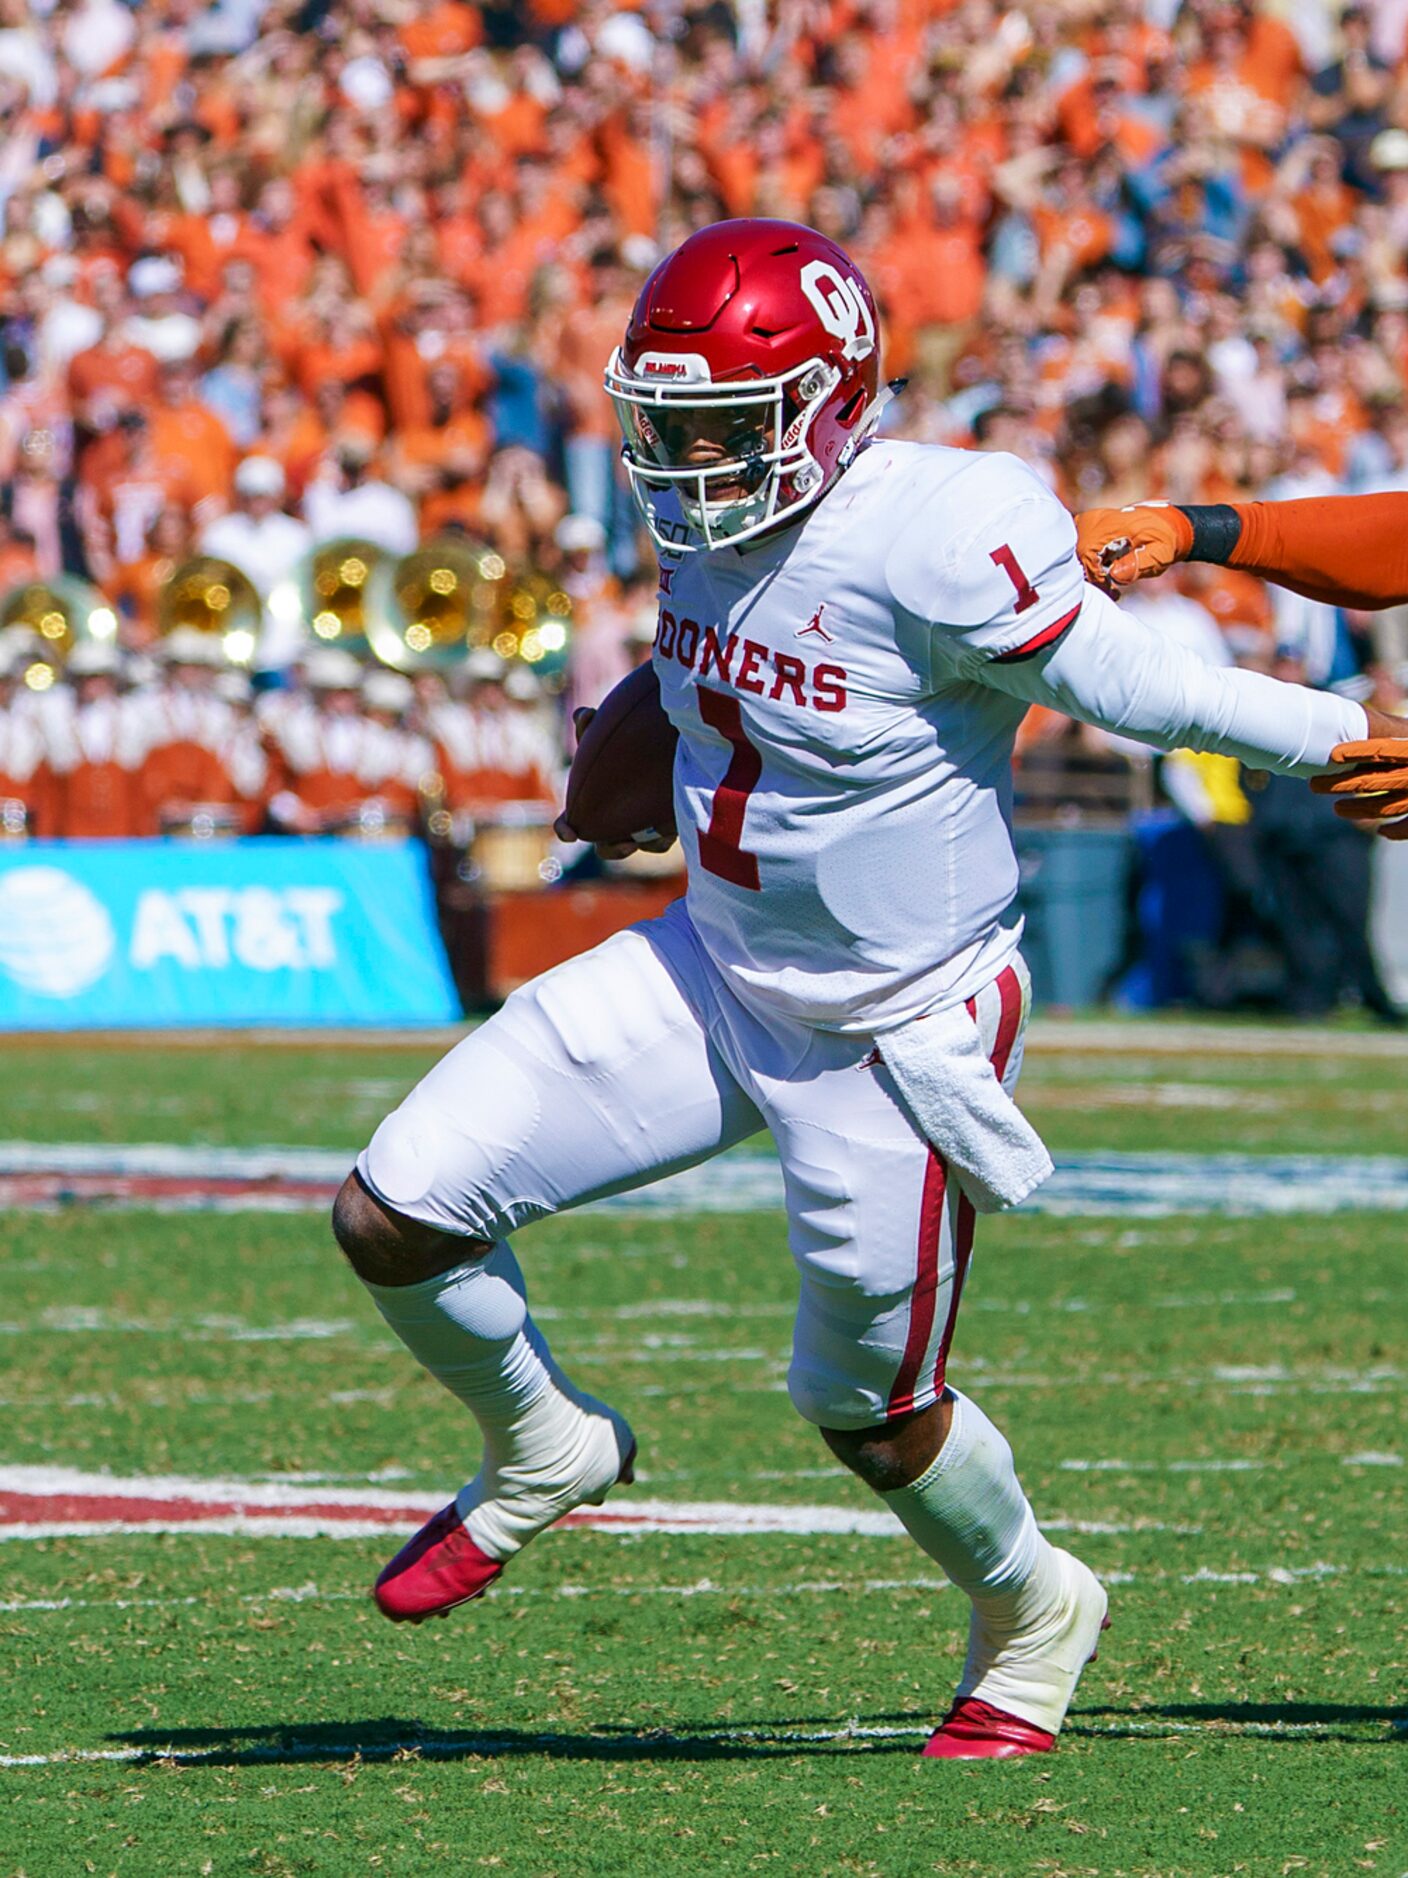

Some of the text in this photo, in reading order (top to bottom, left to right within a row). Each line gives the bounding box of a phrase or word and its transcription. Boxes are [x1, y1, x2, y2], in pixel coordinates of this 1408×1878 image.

[801, 260, 874, 361] OU
[988, 543, 1040, 615] 1
[652, 608, 847, 713] OONERS
[129, 886, 344, 971] AT&T
